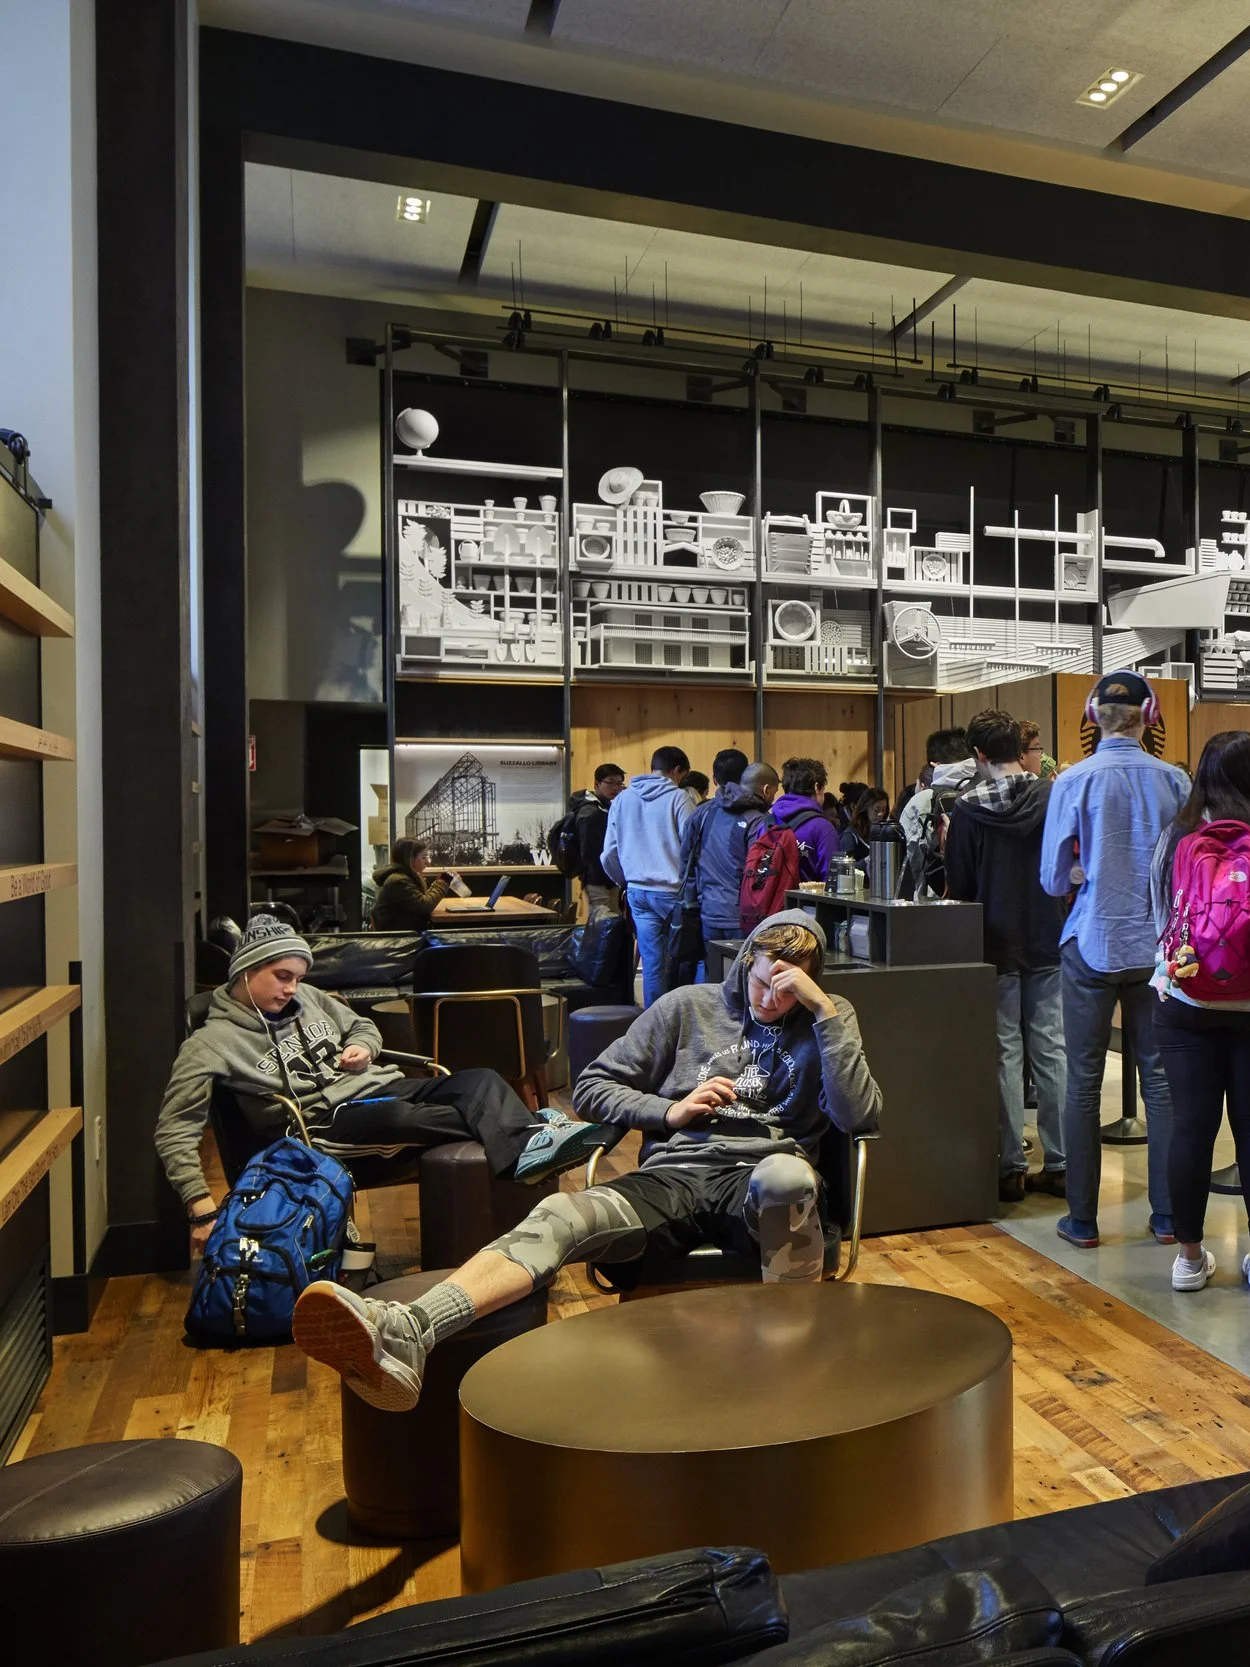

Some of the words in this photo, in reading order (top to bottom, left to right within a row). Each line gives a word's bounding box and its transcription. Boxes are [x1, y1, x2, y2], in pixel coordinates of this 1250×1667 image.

[530, 849, 552, 866] W
[740, 1066, 760, 1079] STEP
[735, 1077, 763, 1088] CLOSER
